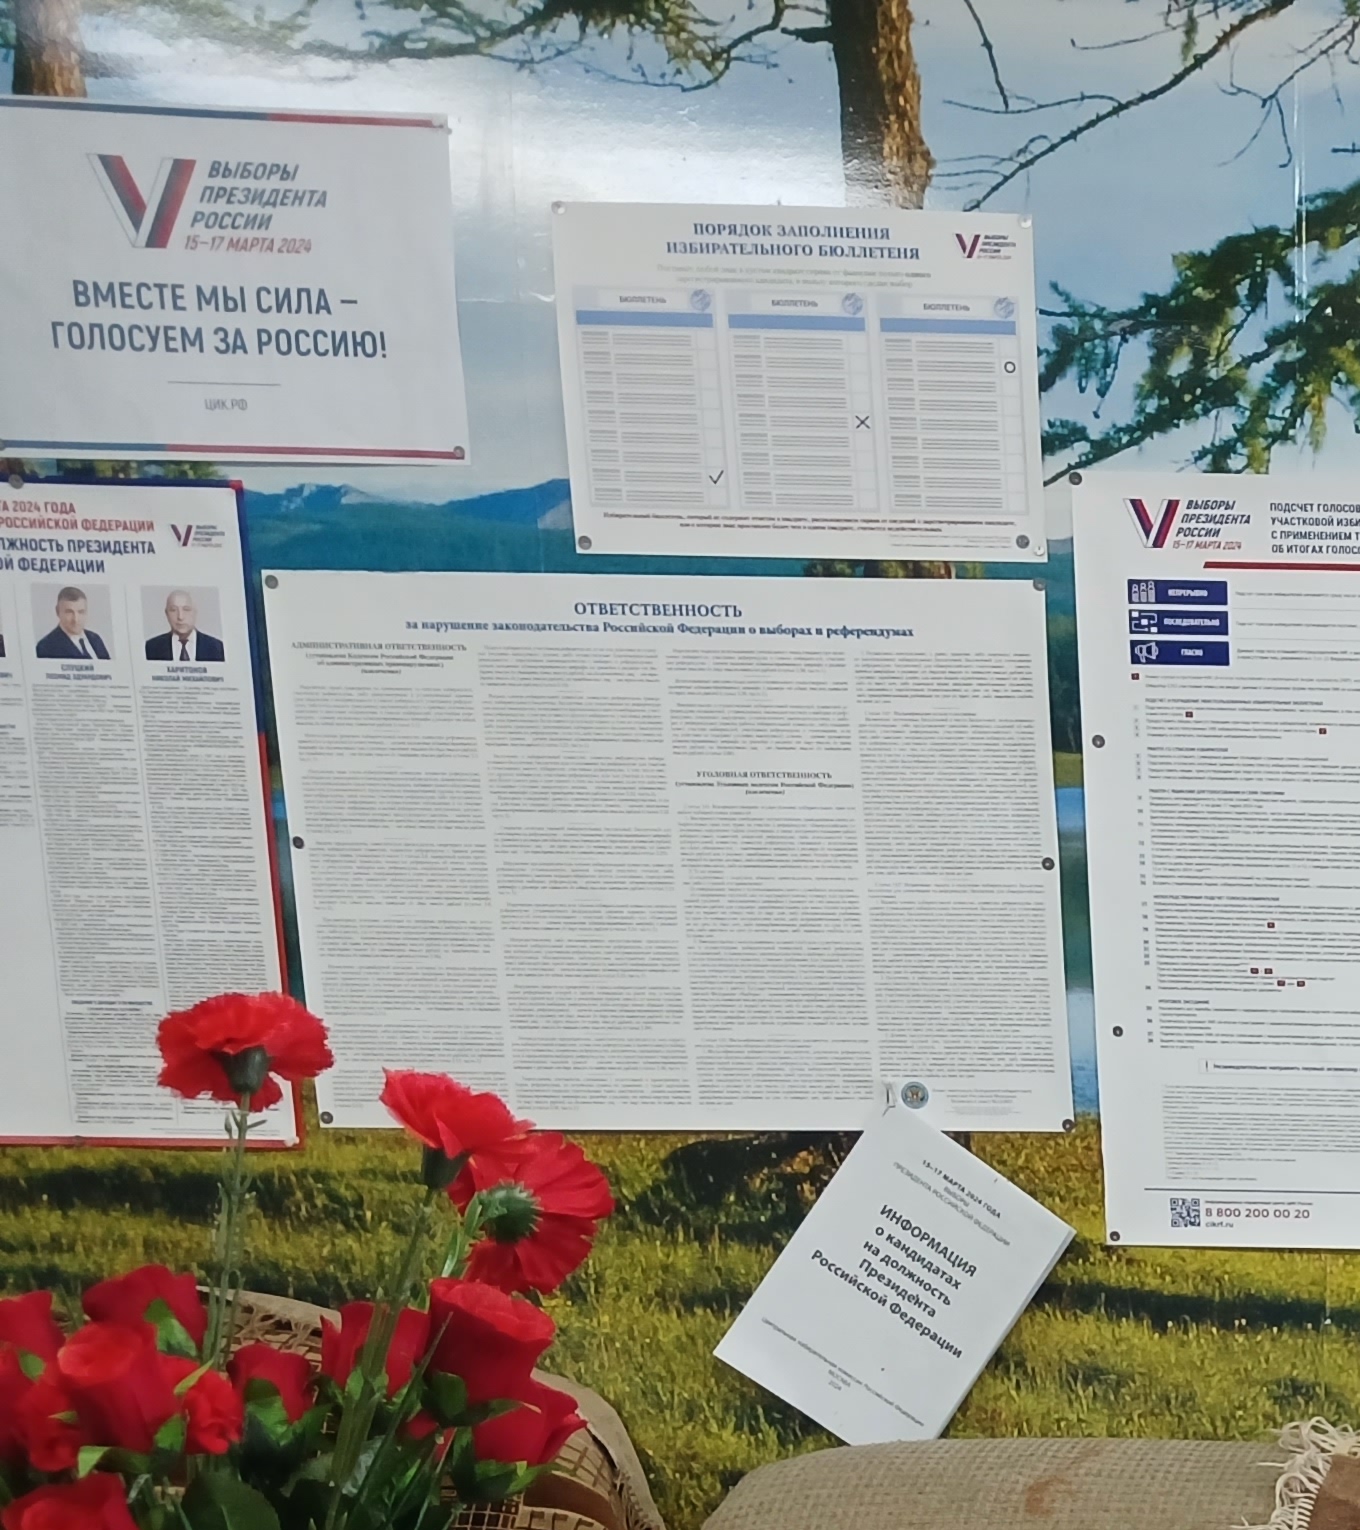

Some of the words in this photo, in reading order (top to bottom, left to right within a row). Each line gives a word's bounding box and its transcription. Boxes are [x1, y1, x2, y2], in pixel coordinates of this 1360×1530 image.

[208, 160, 299, 182] ВЫБОРЫ
[200, 185, 328, 209] ПРЕЗИДЕНТА
[190, 211, 272, 231] РОССИИ
[693, 223, 772, 238] ПОРЯДОК
[777, 224, 890, 240] ЗАПОЛНЕНИЯ
[226, 236, 276, 254] МАРТА
[278, 237, 312, 254] 2024
[666, 242, 813, 257] ИЗБИРАТЕЛЬНОГО
[819, 244, 920, 260] БЮЛЛЕТЕНЯ
[73, 279, 186, 312] ВМЕСТЕ
[196, 284, 246, 314] МЫ
[256, 287, 332, 316] СИЛА
[51, 321, 205, 354] ГОЛОСУЕМ
[214, 328, 248, 356] ЗА
[257, 329, 387, 358] РОССИЮ!
[204, 398, 248, 412] ЦИК.РФ
[12, 501, 41, 514] 2024
[44, 502, 76, 515] ГОДА
[1186, 500, 1236, 511] ВЫБОРЫ
[1270, 502, 1314, 514] ПОДСЧЕТ
[0, 515, 78, 530] РОССИЙСКОЙ
[81, 518, 155, 533] ФЕДЕРАЦИИ
[1181, 514, 1251, 525] ПРЕЗИДЕНТА
[1270, 515, 1334, 527] УЧАСТКОВОЙ
[1176, 527, 1221, 538] РОССИИ
[1271, 531, 1278, 540] С
[1280, 531, 1351, 541] ПРИМЕНЕНИЕМ
[67, 538, 156, 556] ПРЕЗИДЕНТА
[1194, 541, 1221, 550] МАРТА
[1223, 541, 1242, 550] 2024
[1271, 544, 1284, 553] ОБ
[1286, 544, 1324, 554] ИТОГАХ
[18, 556, 105, 573] ФЕДЕРАЦИИ
[574, 602, 742, 619] ОТВЕТСТВЕННОСТЬ
[406, 620, 418, 630] за
[422, 620, 489, 633] нарушение
[492, 621, 599, 633] законодательства
[603, 621, 674, 635] Российской
[677, 623, 746, 638] Федерации
[759, 624, 813, 637] выборах
[826, 625, 915, 640] референдумах
[291, 641, 383, 650] АДМИНИСТРАТИВНАЯ
[385, 643, 467, 652] ОТВЕТСТВЕННОСТЬ
[750, 772, 832, 780] ОТВЕТСТВЕННОСТЬ
[942, 1172, 966, 1194] МАРТА
[981, 1200, 1002, 1219] ГОДА
[1205, 1208, 1212, 1217] 8
[1216, 1208, 1241, 1217] 800
[1245, 1208, 1269, 1218] 200
[1273, 1209, 1290, 1218] 00
[1294, 1209, 1309, 1219] 20
[880, 1203, 977, 1278] ИНФОРМАЦИЯ
[875, 1225, 885, 1237] о
[885, 1231, 962, 1290] кандидатах
[864, 1240, 881, 1259] на
[880, 1252, 951, 1307] должность
[858, 1258, 936, 1318] Президента
[811, 1249, 888, 1308] Российской
[889, 1301, 963, 1359] Федерации
